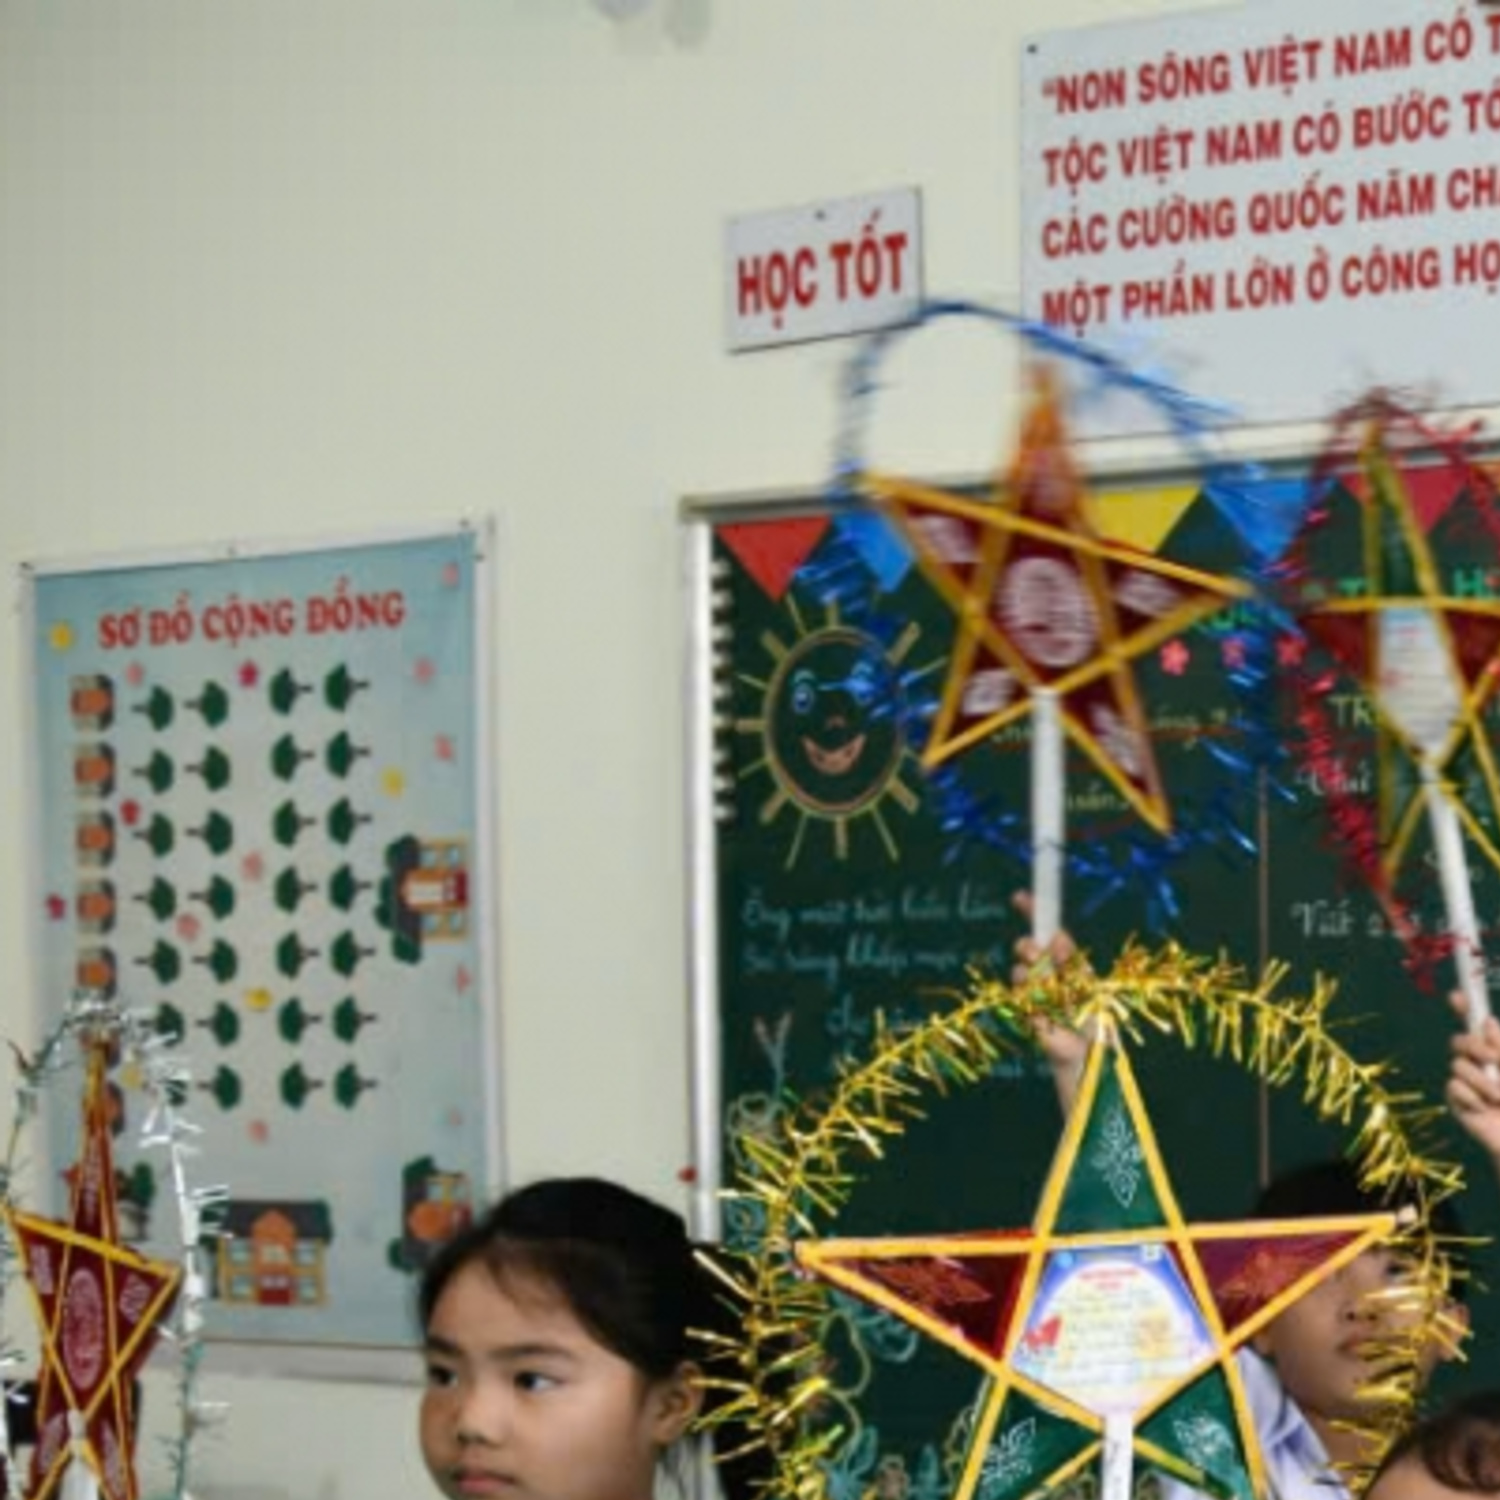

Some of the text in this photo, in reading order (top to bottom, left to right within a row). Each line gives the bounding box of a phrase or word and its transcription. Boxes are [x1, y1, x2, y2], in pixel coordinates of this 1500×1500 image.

[1138, 51, 1231, 104] SÔNG
[1244, 33, 1322, 95] VIỆT
[1334, 26, 1411, 79] NAM
[1423, 5, 1474, 63] CÓ
[1043, 136, 1107, 198] TỘC
[1118, 124, 1194, 185] VIỆT
[1205, 118, 1281, 167] NAM
[1293, 99, 1340, 157] CÓ
[1352, 88, 1450, 148] BƯỚC
[1043, 205, 1108, 258] CÁC
[1118, 194, 1237, 249] CƯỜNG
[1248, 170, 1346, 235] QUỐC
[1357, 168, 1434, 222] NĂM
[737, 207, 908, 330] HỌC TỐT
[1043, 280, 1111, 338] MỘT
[1226, 255, 1294, 311] LỚN
[1341, 245, 1441, 298] CÔNG
[98, 575, 405, 650] SƠ ĐỒ CỘNG ĐỒNG
